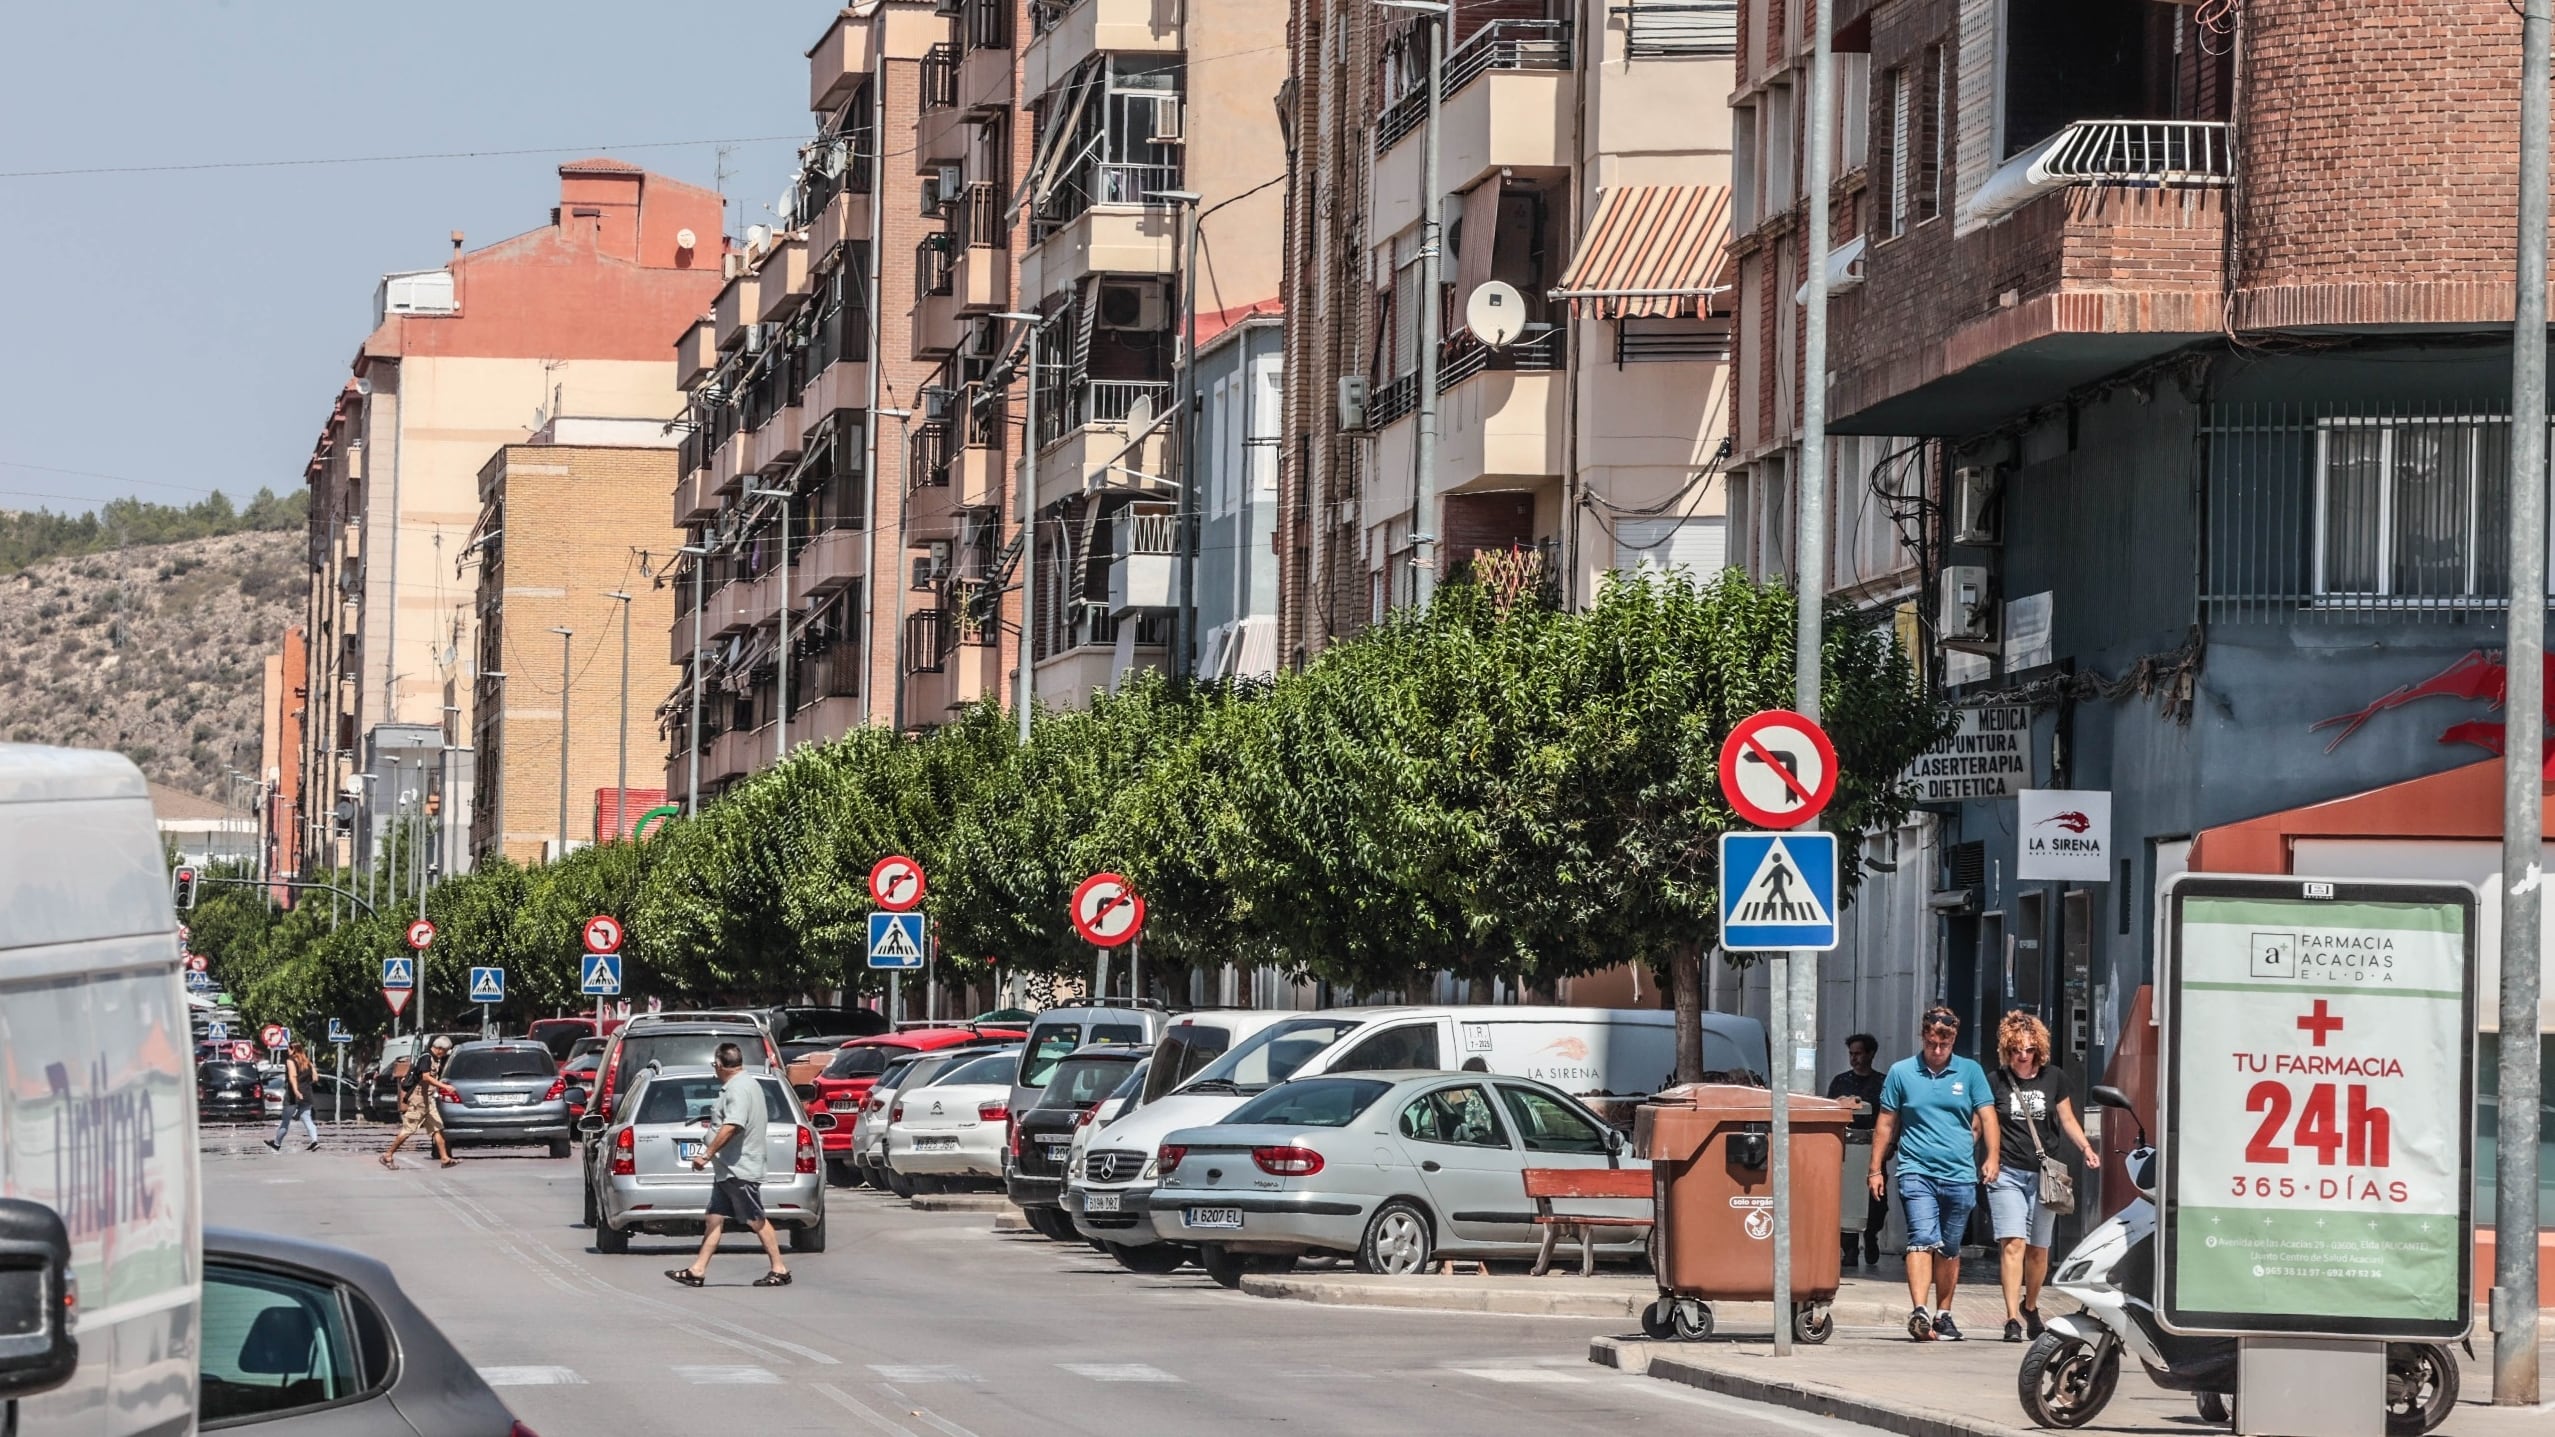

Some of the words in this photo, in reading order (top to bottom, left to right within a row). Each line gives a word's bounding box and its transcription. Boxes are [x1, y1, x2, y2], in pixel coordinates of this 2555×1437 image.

[1978, 707, 2027, 731] MEDICA
[1926, 734, 2018, 755] CUPUNTURA
[1911, 755, 2024, 777] LASERTERAPIA
[1929, 778, 2006, 798] DIETETICA
[2029, 838, 2045, 850] LA
[2052, 838, 2100, 852] SIRENA
[2301, 934, 2394, 950] FARMACIA
[2301, 953, 2393, 968] ACACIAS
[1528, 1068, 1544, 1079] LA
[1550, 1067, 1601, 1079] SIRENA
[2232, 1053, 2267, 1073] TU
[2275, 1055, 2404, 1078] FARMACIA
[2245, 1080, 2390, 1168] 24h
[1191, 1209, 1198, 1223] A
[1200, 1209, 1225, 1223] 6207
[1226, 1209, 1239, 1223] EL
[2280, 1252, 2309, 1262] Centro
[2323, 1254, 2348, 1263] Salud
